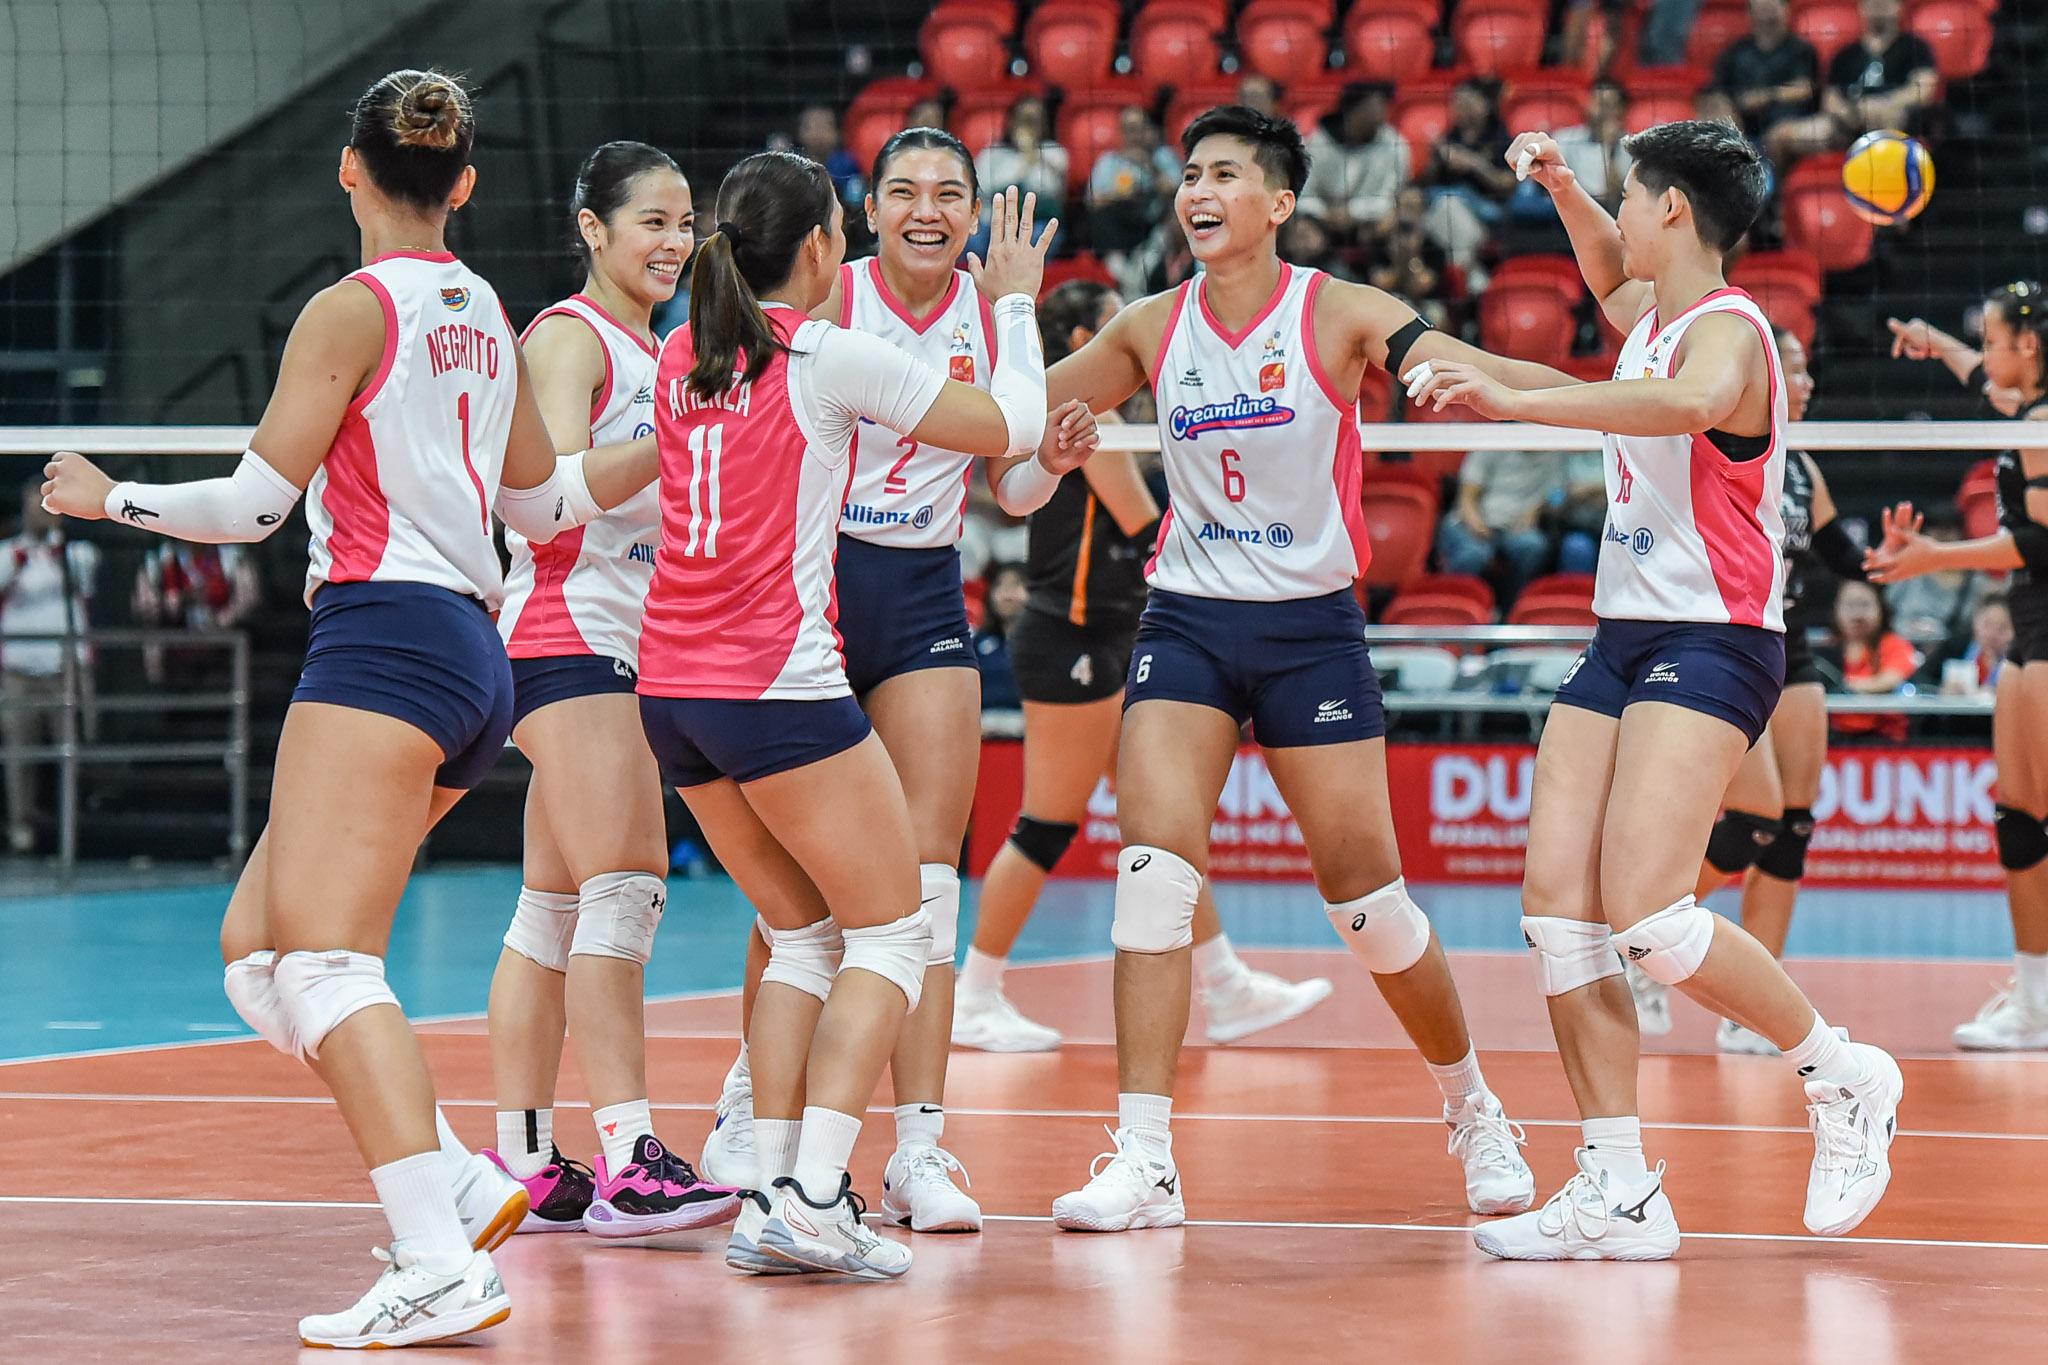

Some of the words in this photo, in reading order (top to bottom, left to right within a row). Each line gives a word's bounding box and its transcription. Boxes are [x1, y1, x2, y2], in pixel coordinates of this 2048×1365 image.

[426, 323, 499, 380] NEGRITO
[1169, 395, 1275, 439] Creamline
[458, 392, 489, 536] 1
[885, 436, 918, 486] 2
[1220, 449, 1246, 503] 6
[684, 423, 724, 558] 11
[840, 503, 911, 525] Allianz
[628, 542, 656, 566] Alli
[1070, 654, 1093, 686] 4
[1136, 654, 1153, 683] 6
[1313, 713, 1353, 723] BALANCE
[1318, 708, 1348, 717] WORLD
[1429, 754, 1536, 820] DU
